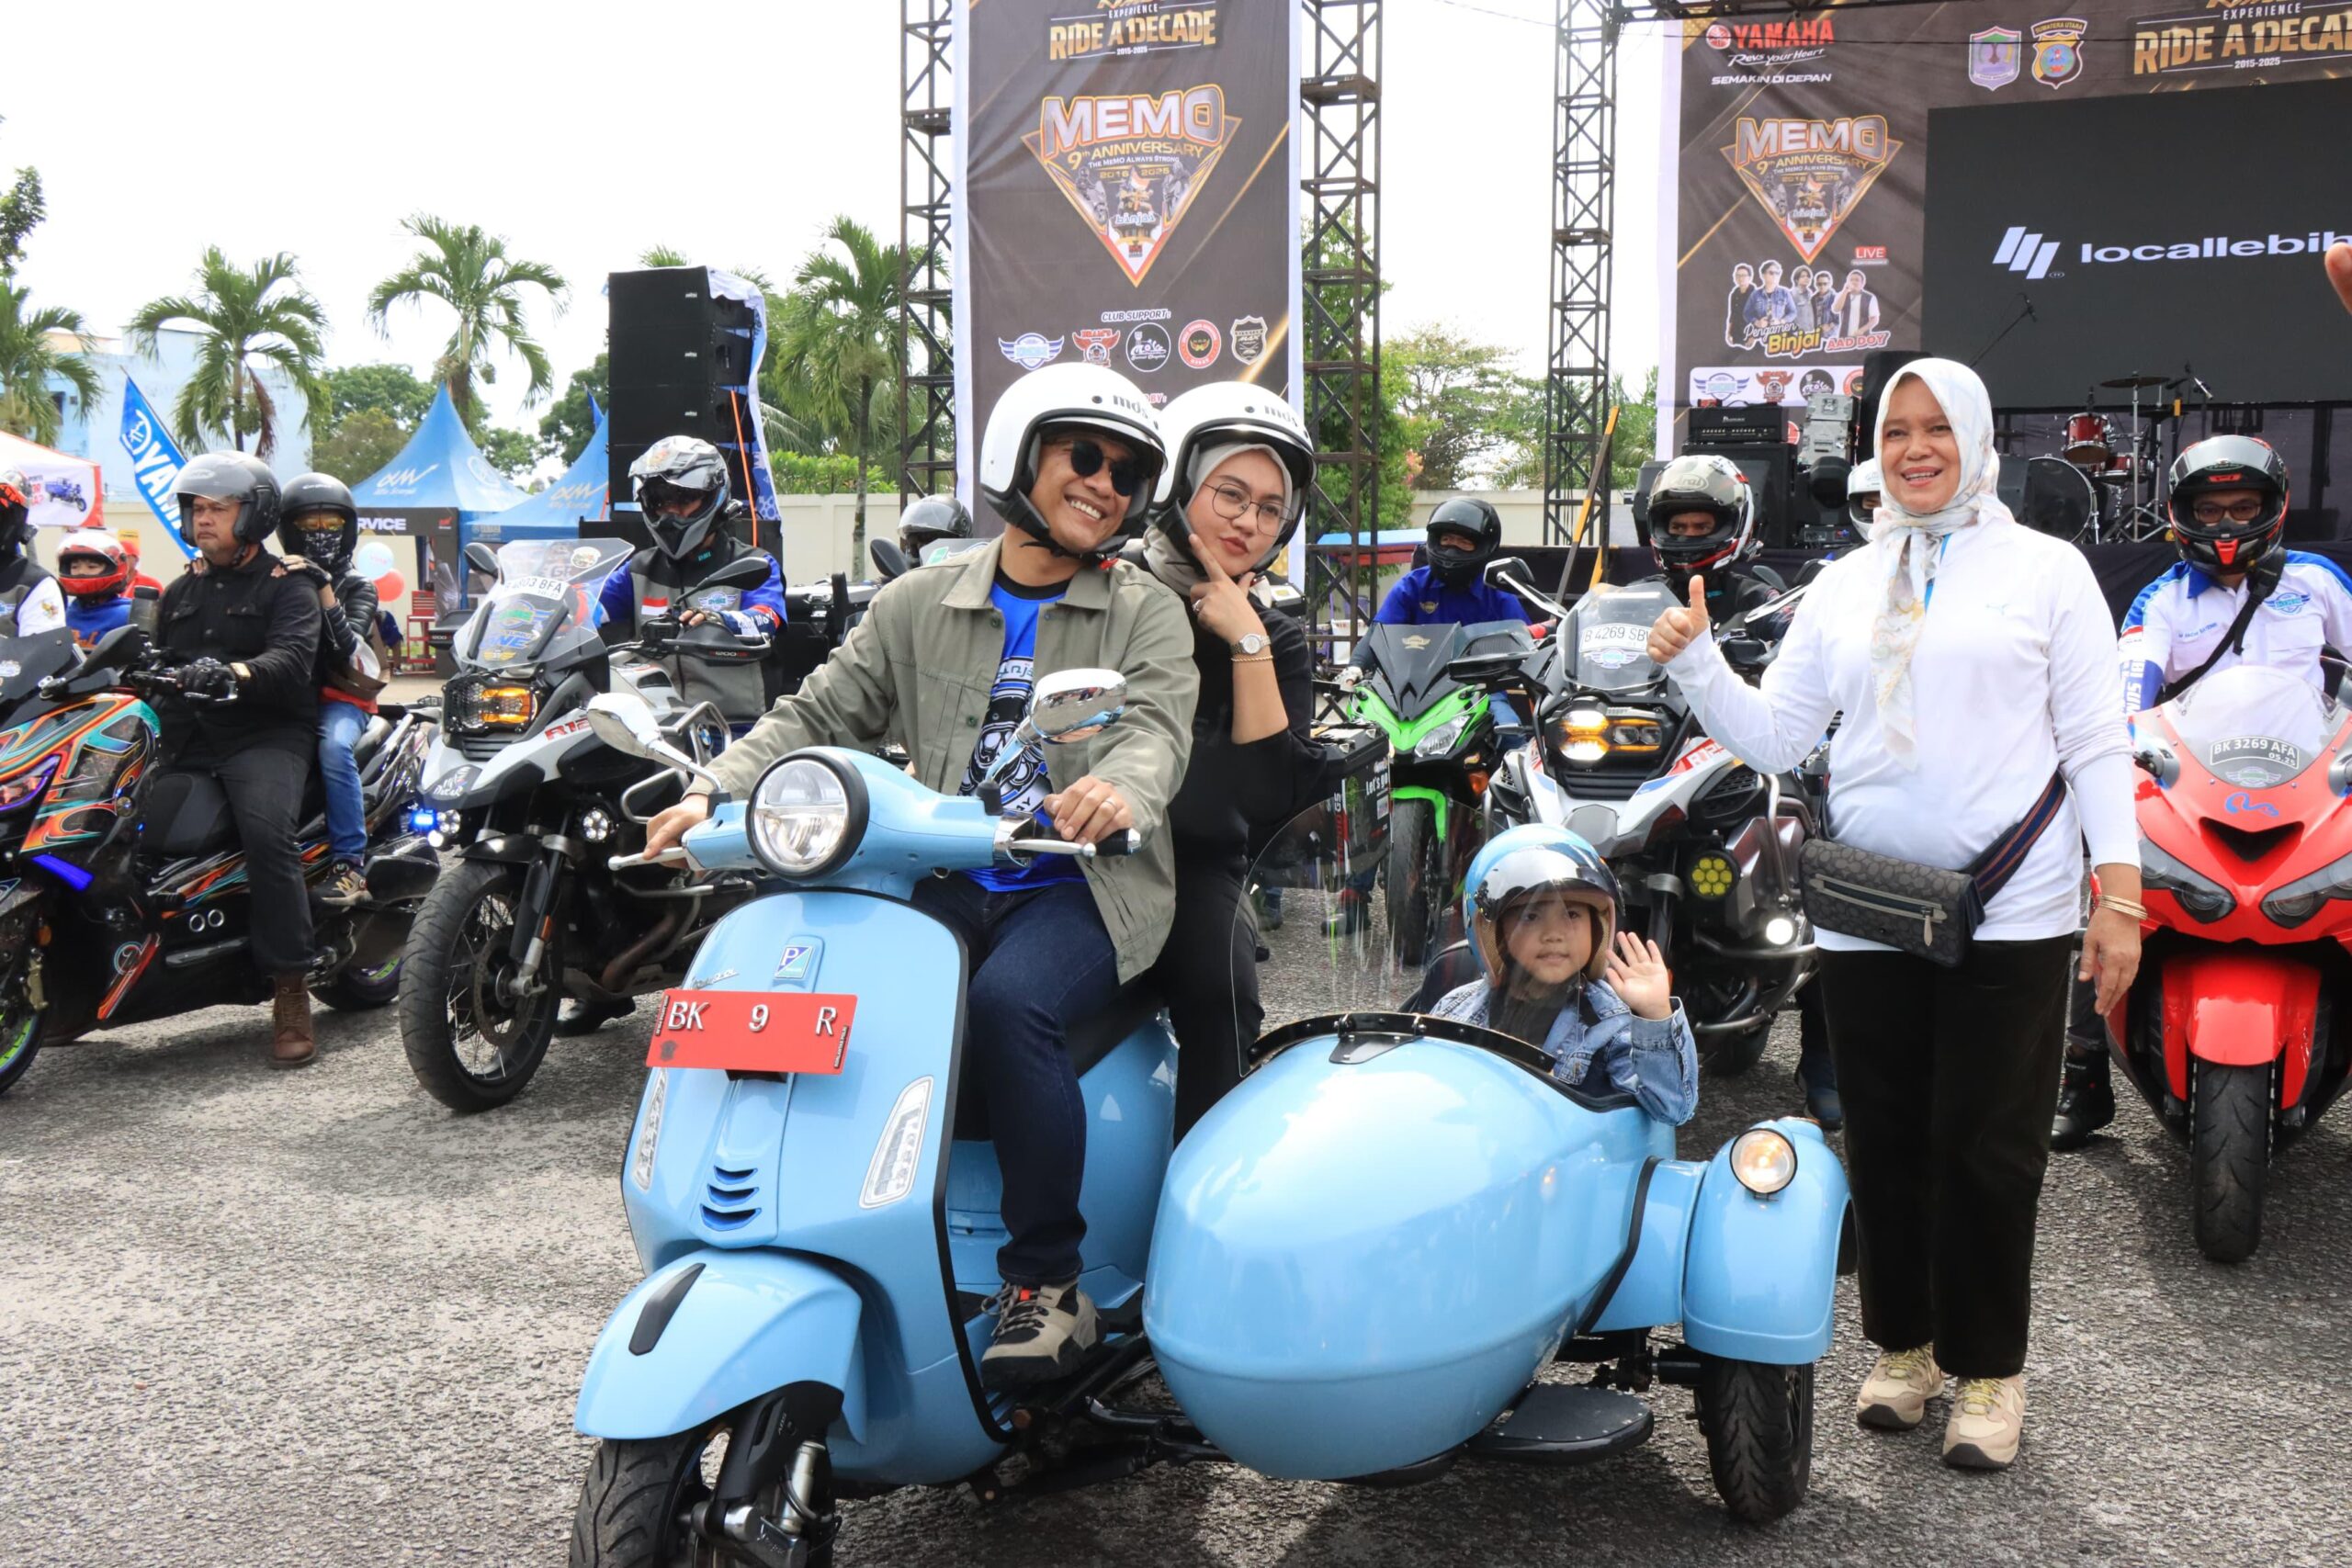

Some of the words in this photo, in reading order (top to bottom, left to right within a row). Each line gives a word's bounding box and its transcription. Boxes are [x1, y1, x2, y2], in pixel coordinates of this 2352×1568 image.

[1108, 3, 1159, 18] EXPERIENCE
[2222, 3, 2301, 20] EXPERIENCE
[1049, 22, 1104, 61] RIDE
[1107, 20, 1124, 46] A
[1733, 17, 1835, 50] YAMAHA
[1116, 46, 1148, 56] 2015-2025
[2133, 26, 2215, 74] RIDE
[2221, 24, 2246, 57] A
[2234, 57, 2281, 70] 2015-2025
[1711, 74, 1770, 85] SEMAKIN
[1771, 74, 1784, 84] DI
[1785, 73, 1832, 84] DEPAN
[1041, 85, 1224, 160] MEMO
[1736, 116, 1887, 168] MEMO
[1091, 141, 1204, 161] ANNIVERSARY
[1775, 153, 1870, 170] ANNIVERSARY
[1856, 248, 1884, 258] LIVE
[1102, 310, 1125, 321] CLUB
[1744, 321, 1796, 341] Pengamen
[1767, 328, 1822, 355] Binjai
[1826, 337, 1854, 350] AAD
[1857, 333, 1888, 347] DOY
[1584, 630, 1593, 642] B
[1594, 626, 1625, 639] 4269
[1628, 627, 1648, 641] SB
[2213, 740, 2231, 755] BK
[2233, 739, 2268, 750] 3269
[2270, 741, 2296, 759] AFA
[2268, 751, 2296, 766] 05.25
[780, 947, 800, 965] P
[667, 1000, 710, 1032] BK
[748, 1003, 771, 1033] 9
[815, 1005, 838, 1036] R
